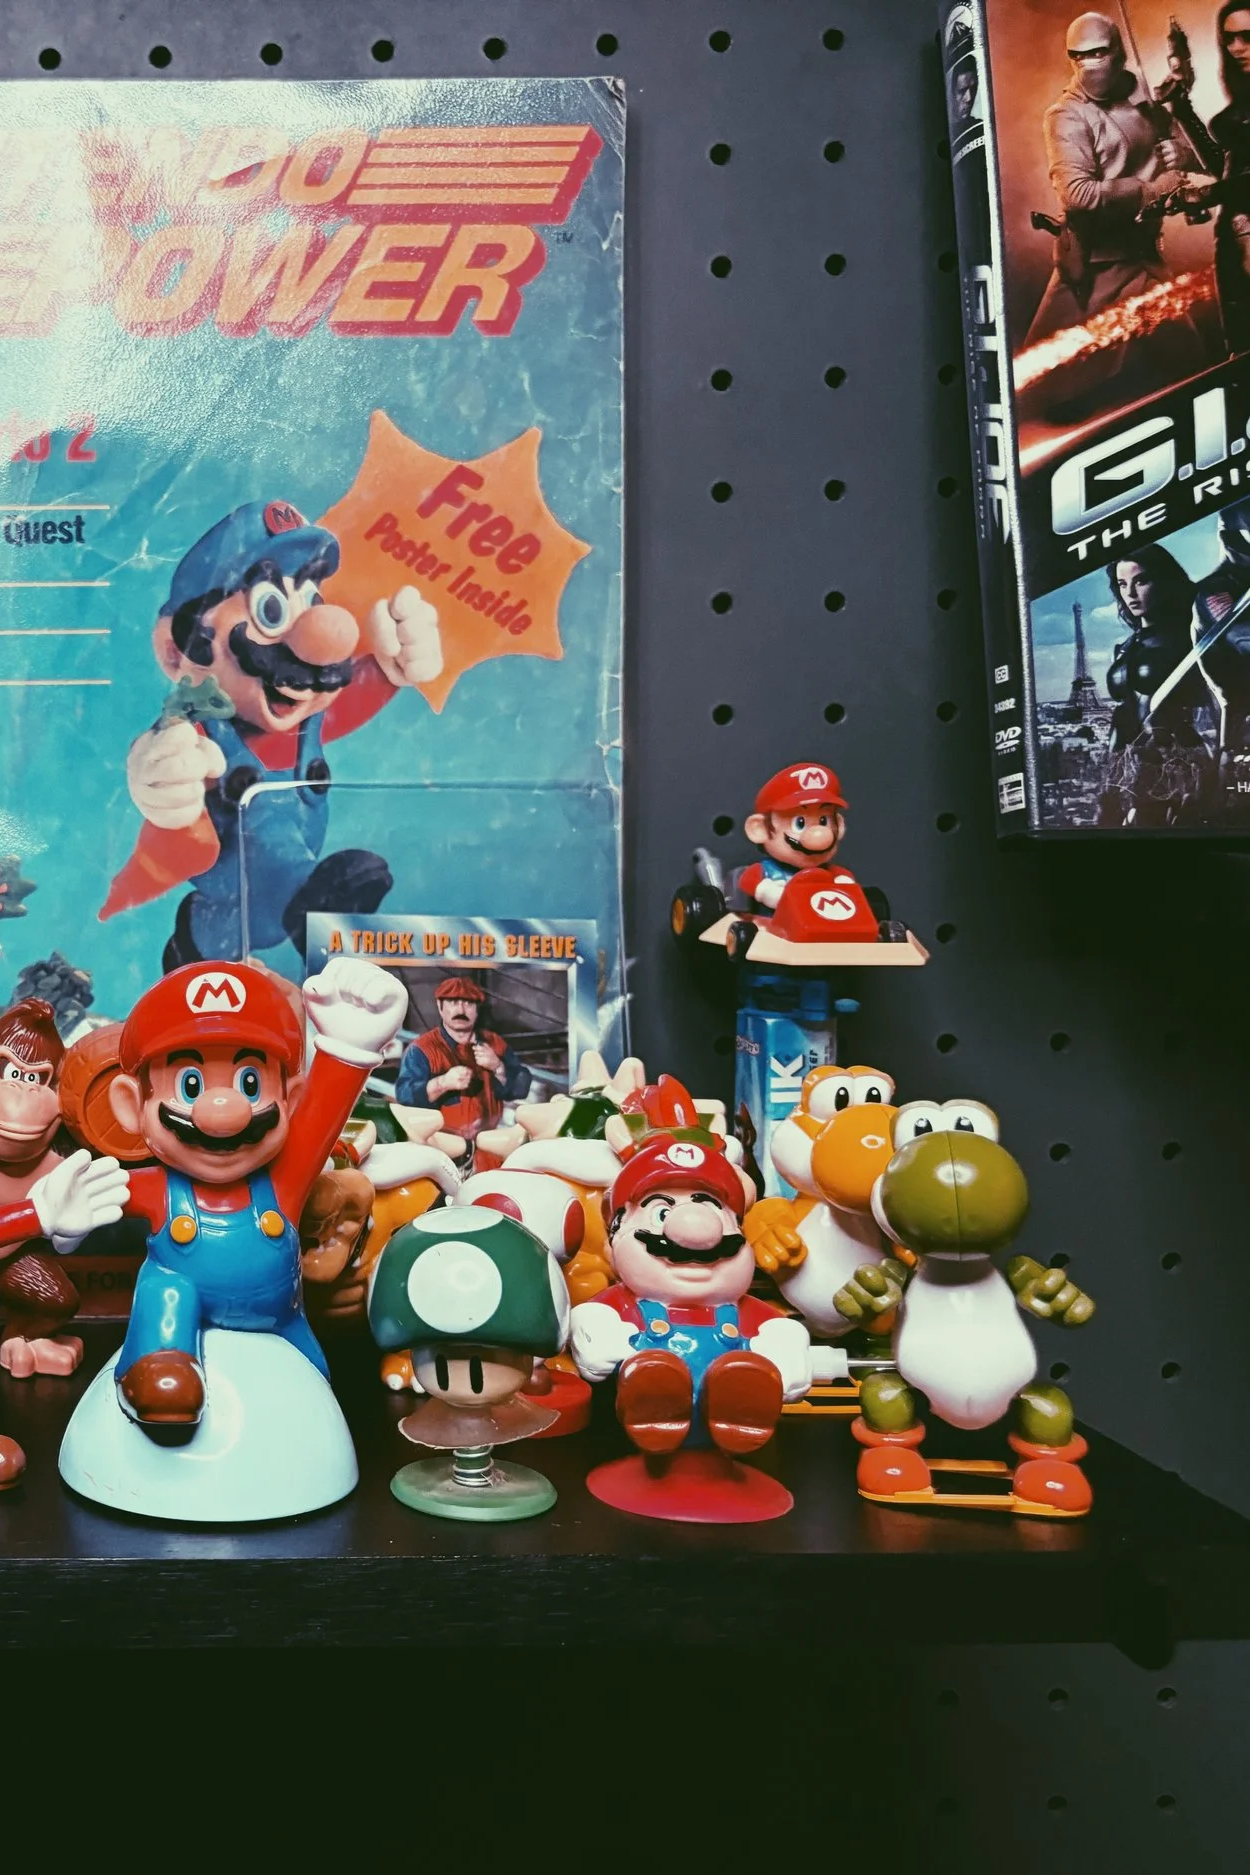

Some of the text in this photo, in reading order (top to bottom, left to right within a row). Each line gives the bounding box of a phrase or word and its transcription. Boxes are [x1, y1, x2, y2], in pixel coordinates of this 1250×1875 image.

[15, 221, 548, 338] POWER
[66, 411, 98, 463] 2
[1051, 388, 1246, 535] G.I.
[4, 514, 86, 547] Quest
[416, 463, 542, 575] Free
[1067, 502, 1168, 561] THE
[363, 511, 533, 636] Poster Inside
[995, 726, 1022, 744] DVD
[802, 771, 826, 788] M
[817, 896, 853, 912] M
[328, 930, 578, 959] A TRICK UP HIS SLEEVE
[192, 978, 241, 1009] M
[675, 1146, 695, 1160] M
